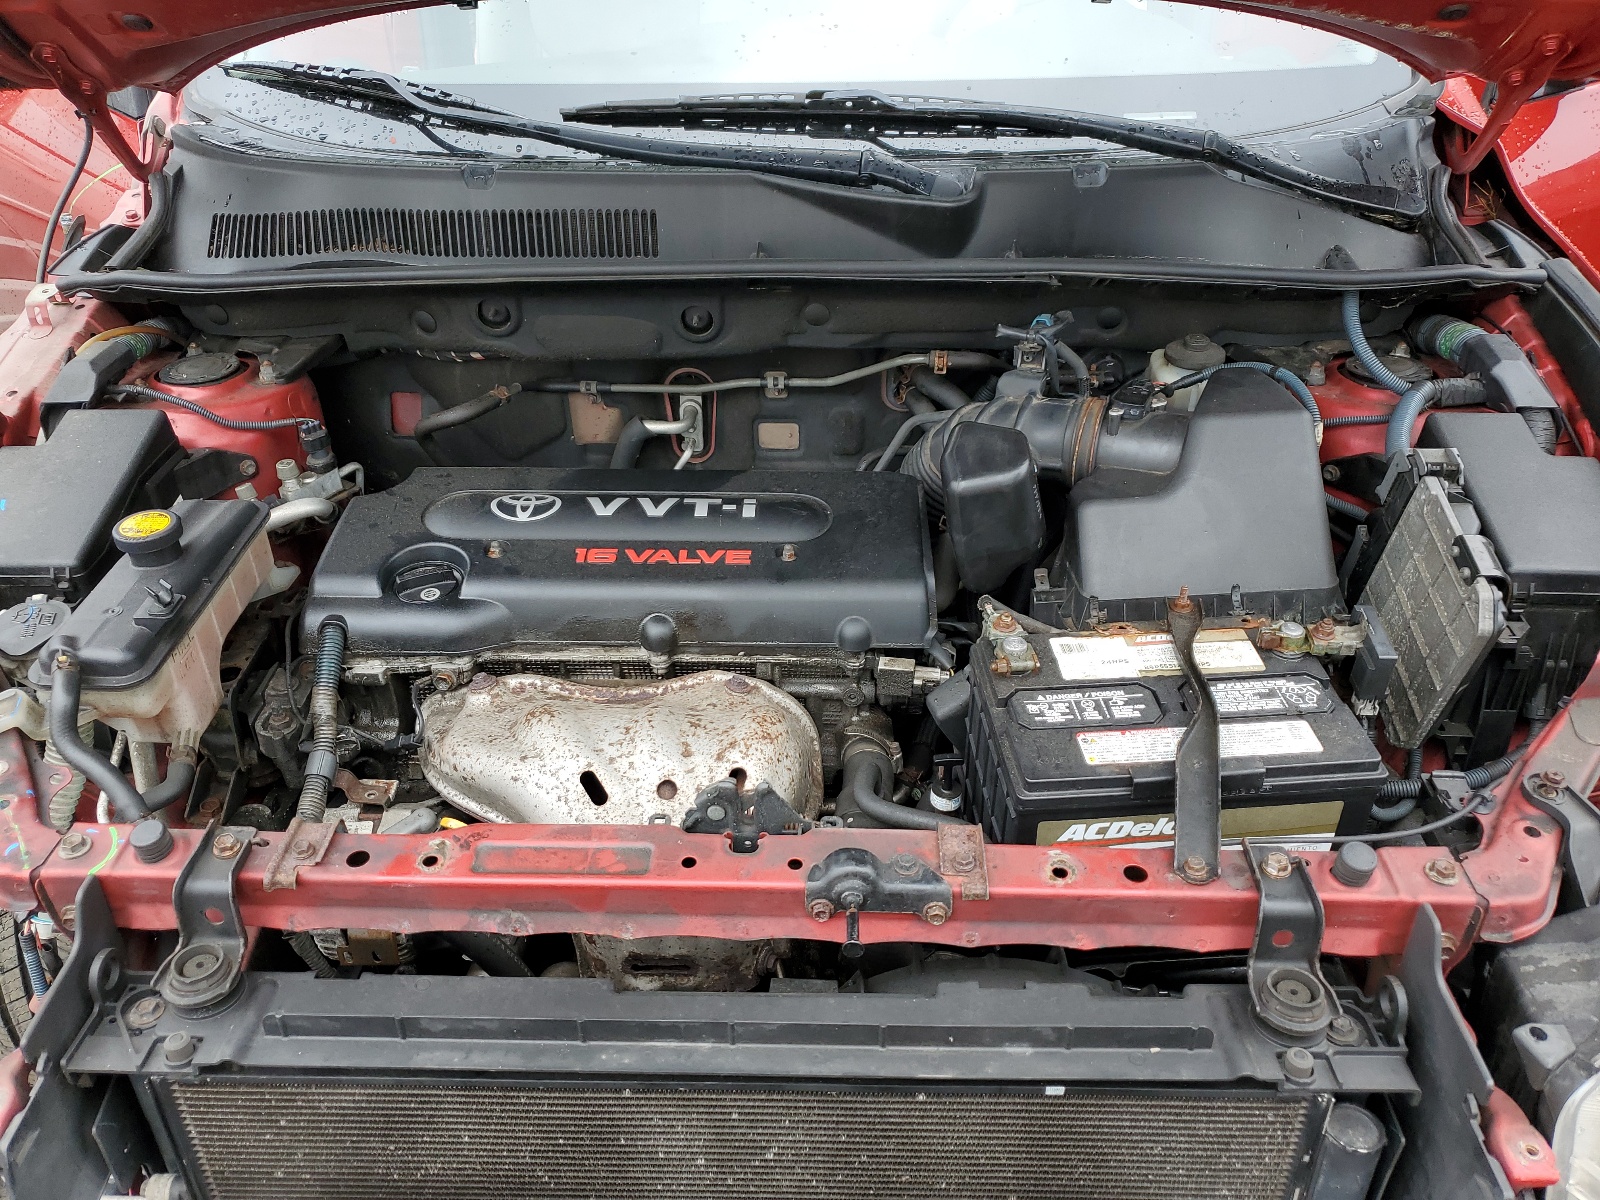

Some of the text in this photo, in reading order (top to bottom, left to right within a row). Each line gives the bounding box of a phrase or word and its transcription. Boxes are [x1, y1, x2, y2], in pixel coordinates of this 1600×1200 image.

[586, 496, 757, 518] VVT-i
[575, 547, 753, 565] 16 VALVE
[1046, 692, 1083, 701] DANGER
[1091, 690, 1125, 699] POISON
